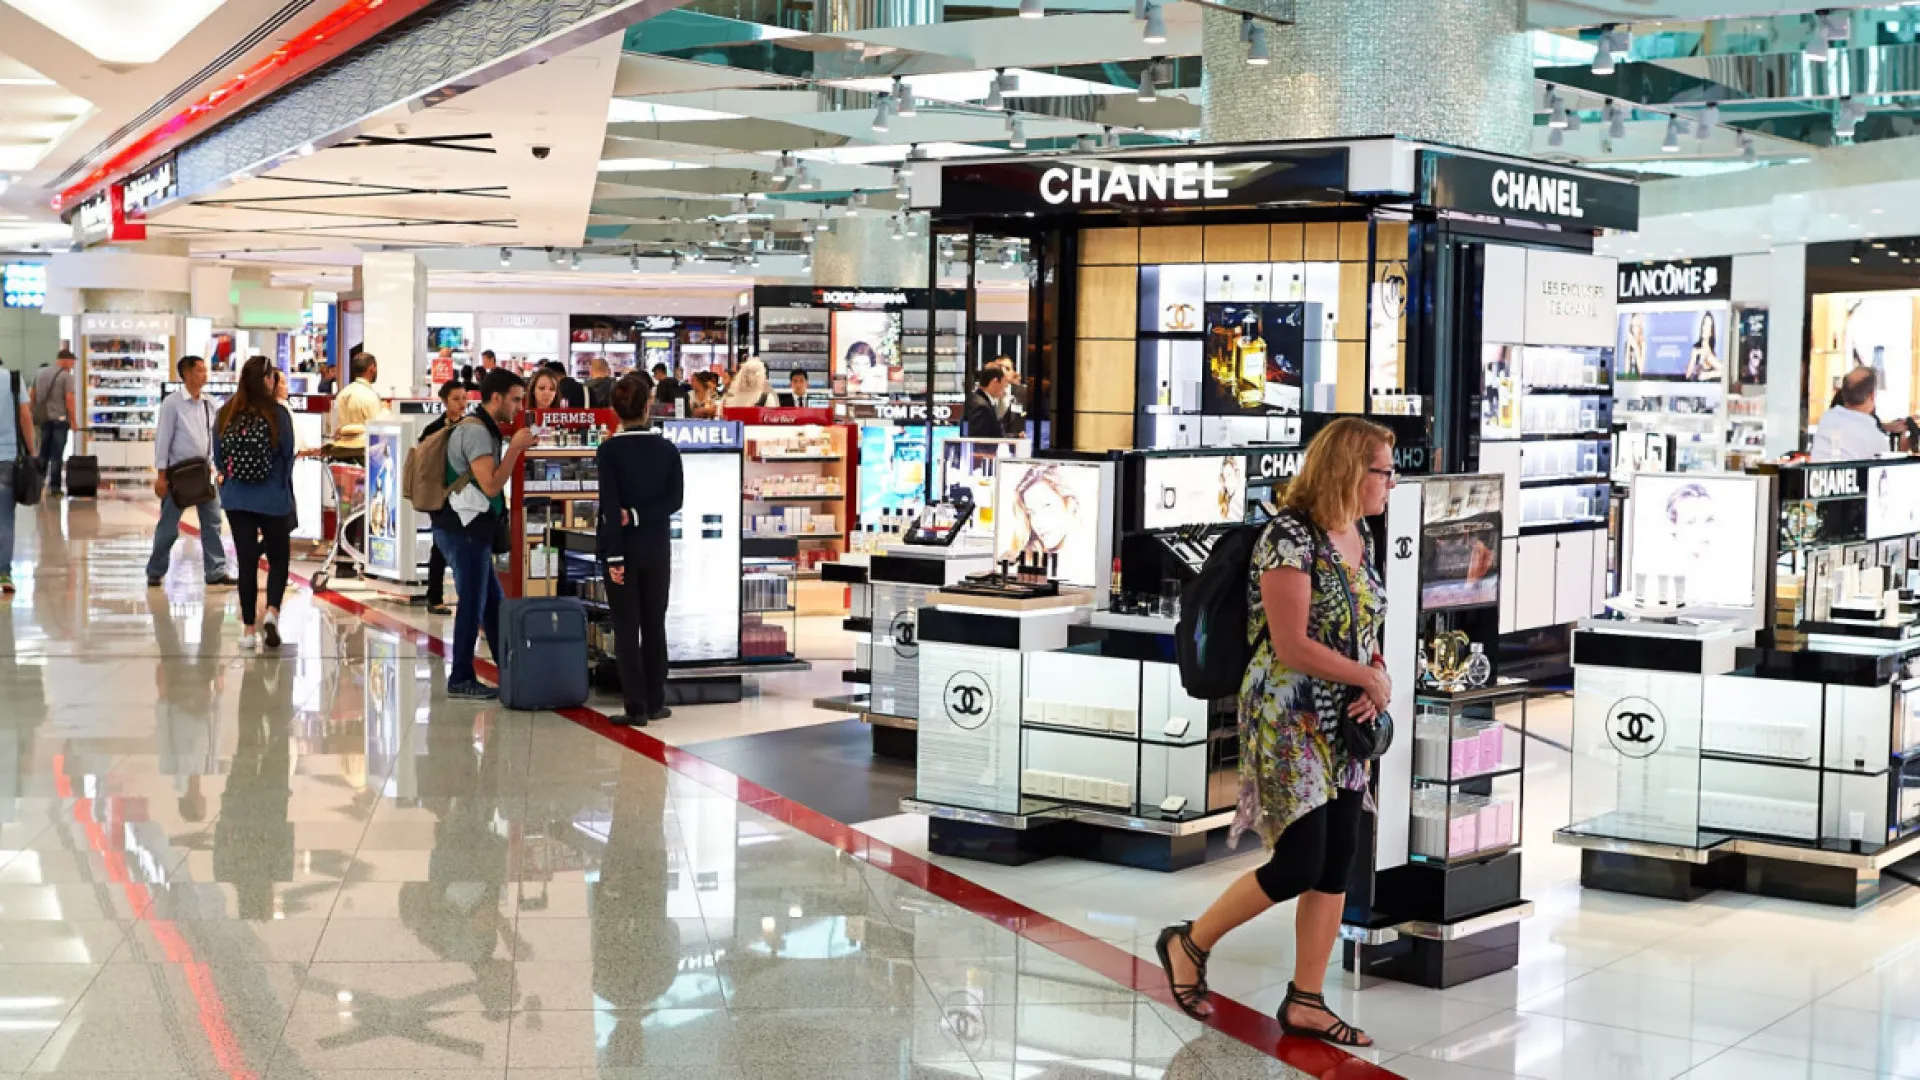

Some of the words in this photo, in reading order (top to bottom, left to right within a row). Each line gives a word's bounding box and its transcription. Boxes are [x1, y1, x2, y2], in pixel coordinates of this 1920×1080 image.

[1039, 161, 1229, 204] CHANEL
[1491, 168, 1584, 218] CHANEL
[1619, 263, 1702, 297] LANCÔME
[874, 405, 909, 419] TOM
[1809, 468, 1860, 497] CHANEL
